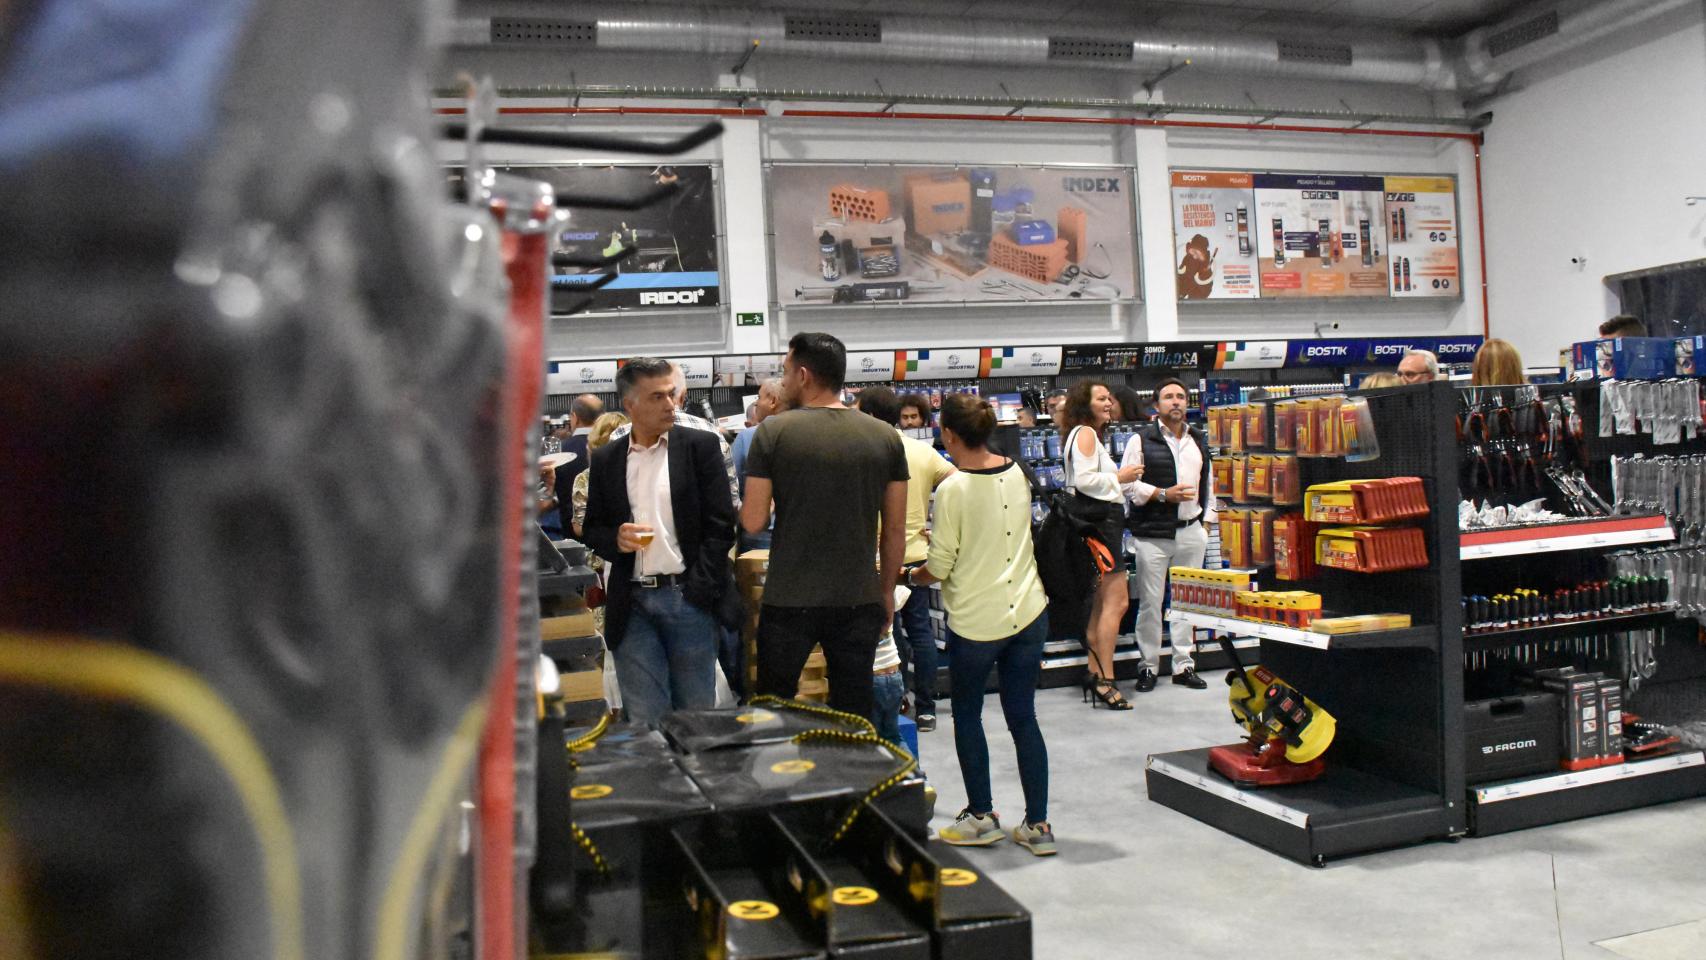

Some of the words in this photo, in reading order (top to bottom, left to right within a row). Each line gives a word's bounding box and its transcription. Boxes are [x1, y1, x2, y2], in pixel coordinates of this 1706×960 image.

[1062, 176, 1120, 192] INDEX
[1144, 345, 1166, 354] SOMOS
[1307, 346, 1348, 356] BOSTIK
[1374, 345, 1413, 355] BOSTIK
[1438, 343, 1477, 353] BOSTIK
[1495, 739, 1537, 752] FACOM
